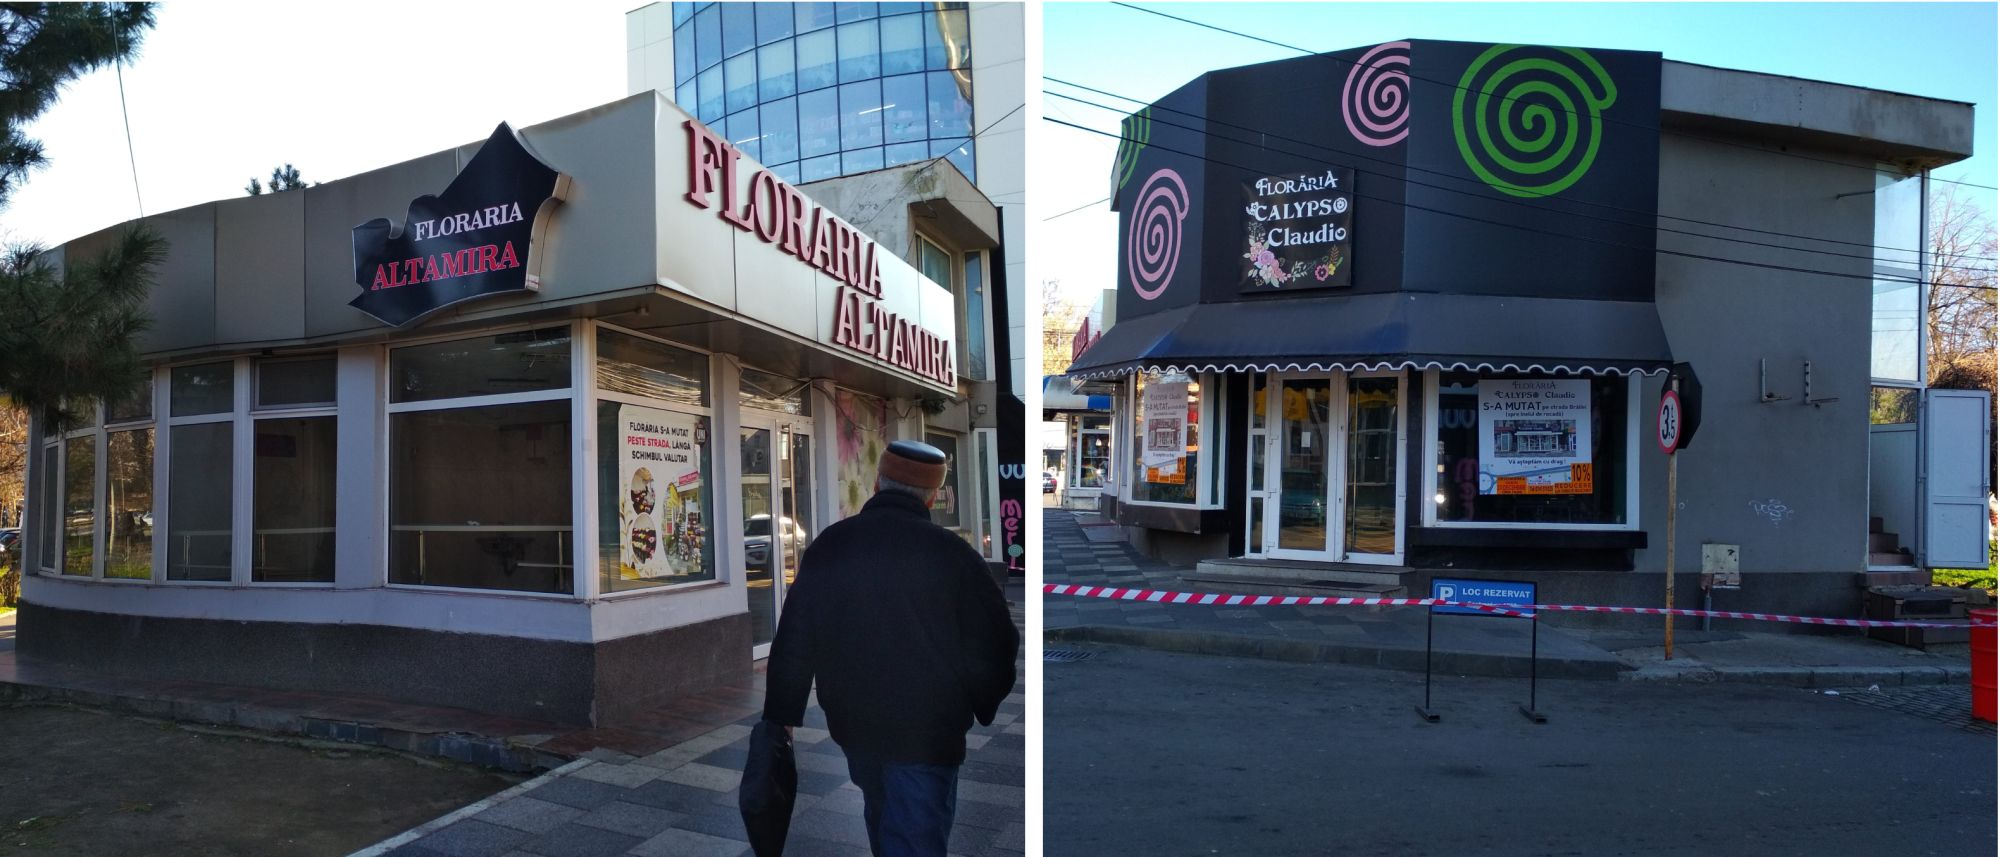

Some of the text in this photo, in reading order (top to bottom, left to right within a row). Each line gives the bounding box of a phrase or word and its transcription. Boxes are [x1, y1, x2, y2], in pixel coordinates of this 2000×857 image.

[683, 119, 885, 300] FLORARIA
[1254, 197, 1348, 221] CALYPSO
[414, 201, 524, 242] FLORARIA
[1267, 223, 1347, 247] Claudio
[371, 240, 520, 291] ALTAMIRA
[834, 285, 955, 387] ALTAMIRA
[1483, 401, 1502, 411] S-A
[1505, 401, 1542, 411] MUTAT
[627, 436, 646, 446] PESTE
[671, 427, 689, 437] MUTAT
[631, 450, 688, 463] SCHIMBUL VALUTAR
[1462, 587, 1481, 596] LOC
[1483, 588, 1531, 599] REZERVAT
